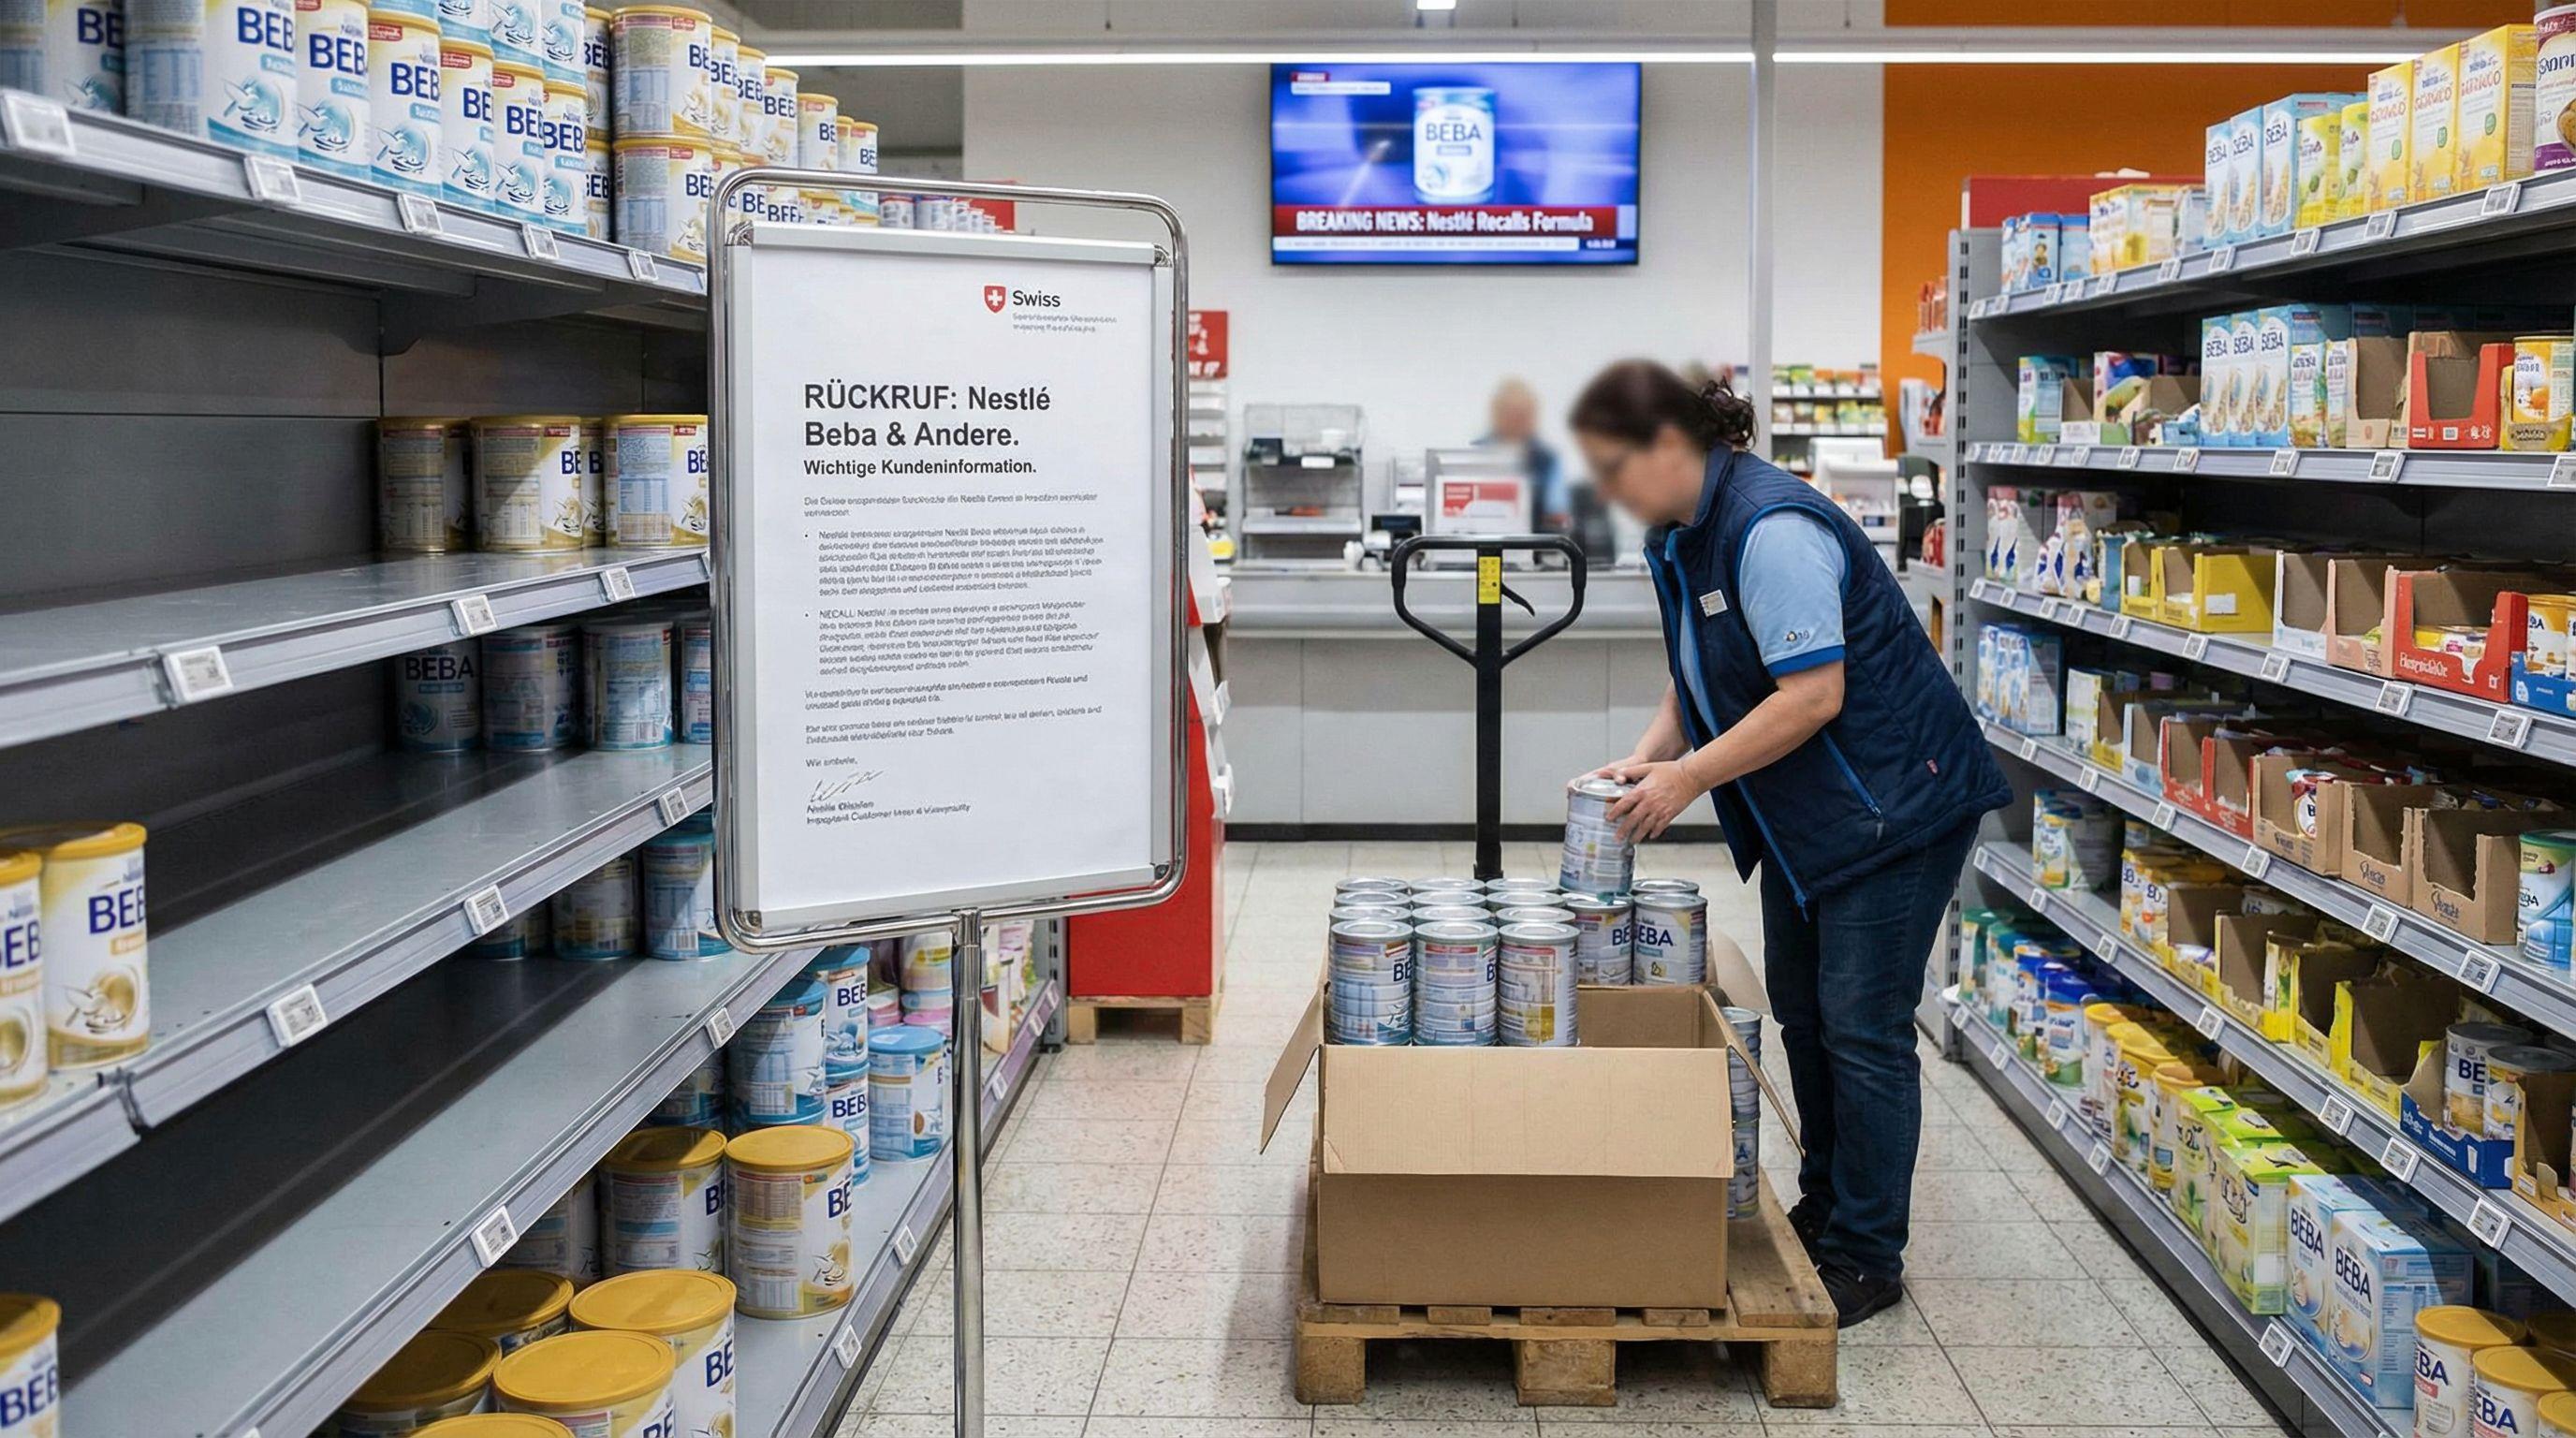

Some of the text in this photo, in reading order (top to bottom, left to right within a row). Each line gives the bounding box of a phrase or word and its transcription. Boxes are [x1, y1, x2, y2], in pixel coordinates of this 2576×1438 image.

[78, 8, 124, 50] BE
[238, 7, 294, 52] BEB
[309, 34, 368, 76] BEB
[391, 62, 439, 102] BEB
[463, 88, 492, 123] BE
[764, 95, 795, 118] BEB
[543, 122, 584, 154] BEB
[819, 123, 836, 142] BE
[1426, 123, 1482, 142] BEBA
[860, 149, 876, 168] BE
[743, 192, 766, 214] BE
[1296, 212, 1593, 232] BREAKING NEWS: Nestlé Recalls Formula
[1013, 290, 1061, 307] Swiss
[804, 378, 1051, 410] RÜCKRUF: Nestlé
[804, 421, 1019, 447] Beba & Andere.
[562, 450, 581, 475] BE
[803, 459, 1037, 478] Wichtige Kundeninformation.
[405, 657, 475, 682] BEBA
[89, 885, 144, 934] BE
[0, 920, 41, 969] EB
[1612, 925, 1630, 946] BE
[1638, 924, 1674, 946] EBA
[2459, 1058, 2486, 1083] BE
[832, 1093, 866, 1118] BEB
[828, 1181, 852, 1218] BE
[2291, 1207, 2325, 1260] BEBA
[2335, 1246, 2372, 1304] BEBA
[706, 1339, 734, 1387] BE
